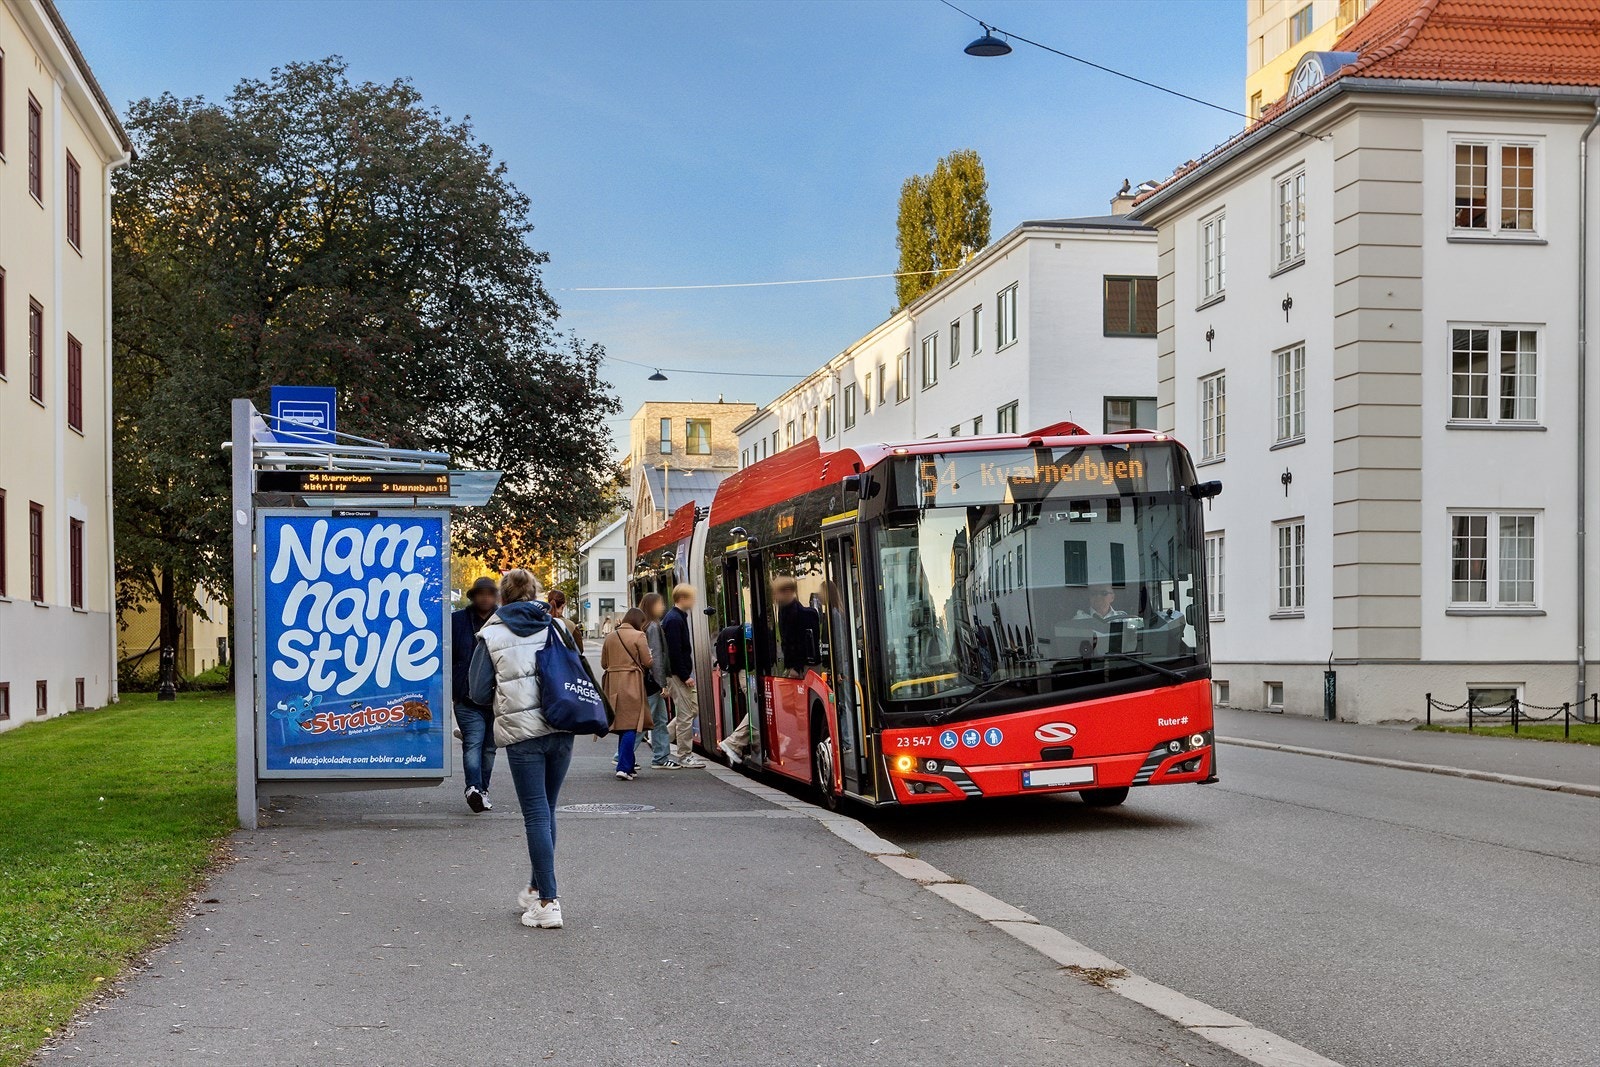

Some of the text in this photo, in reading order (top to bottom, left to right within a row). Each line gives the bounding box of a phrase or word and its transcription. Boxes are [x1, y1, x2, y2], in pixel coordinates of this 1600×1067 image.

[321, 474, 372, 482] Kværnerbyen
[921, 456, 1143, 497] 54 Kværnerbyen
[270, 519, 436, 584] Nam-
[282, 572, 428, 638] nam
[311, 705, 405, 735] Stratos
[1158, 716, 1189, 727] Ruter#
[897, 735, 932, 747] 23 547
[290, 755, 352, 766] Melkesjokoladen
[370, 755, 394, 763] bobler
[404, 754, 427, 765] glede
